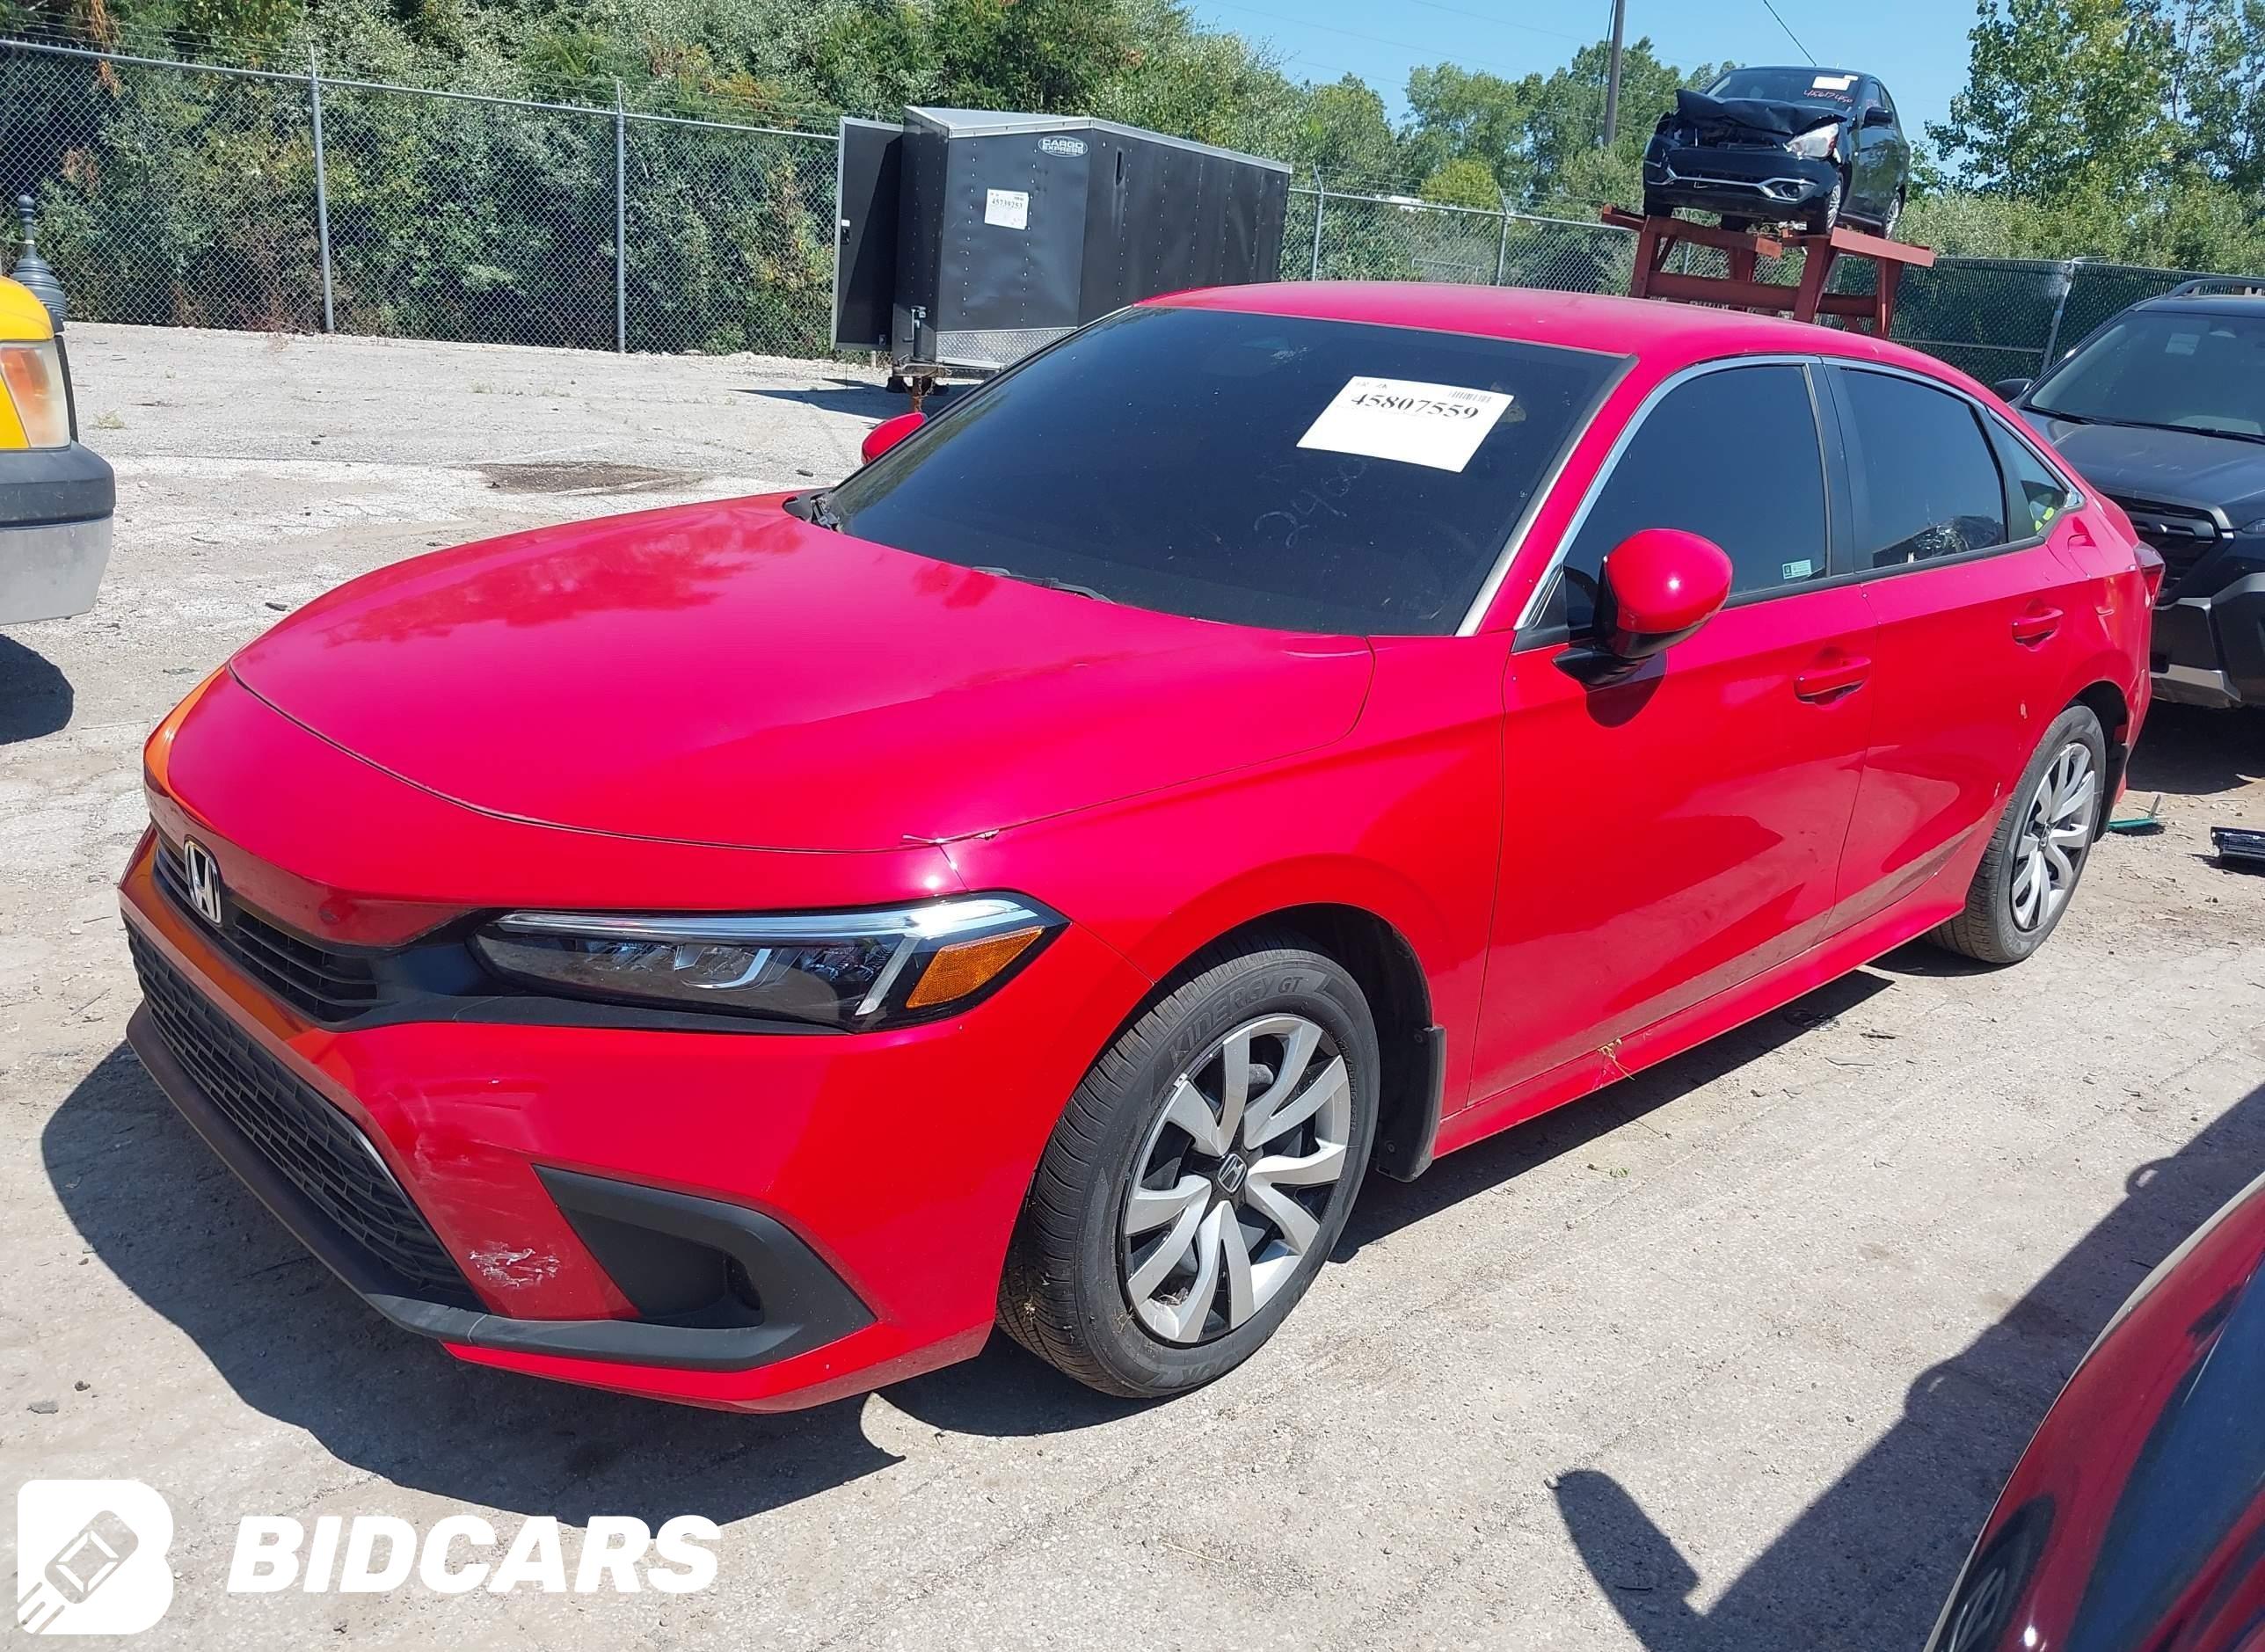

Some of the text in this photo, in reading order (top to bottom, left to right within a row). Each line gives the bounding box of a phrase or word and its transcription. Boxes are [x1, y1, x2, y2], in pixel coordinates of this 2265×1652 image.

[1042, 139, 1084, 149] CARGO
[1042, 144, 1084, 154] EXPRESS
[1351, 393, 1480, 419] 45807559
[1278, 975, 1304, 993] GT
